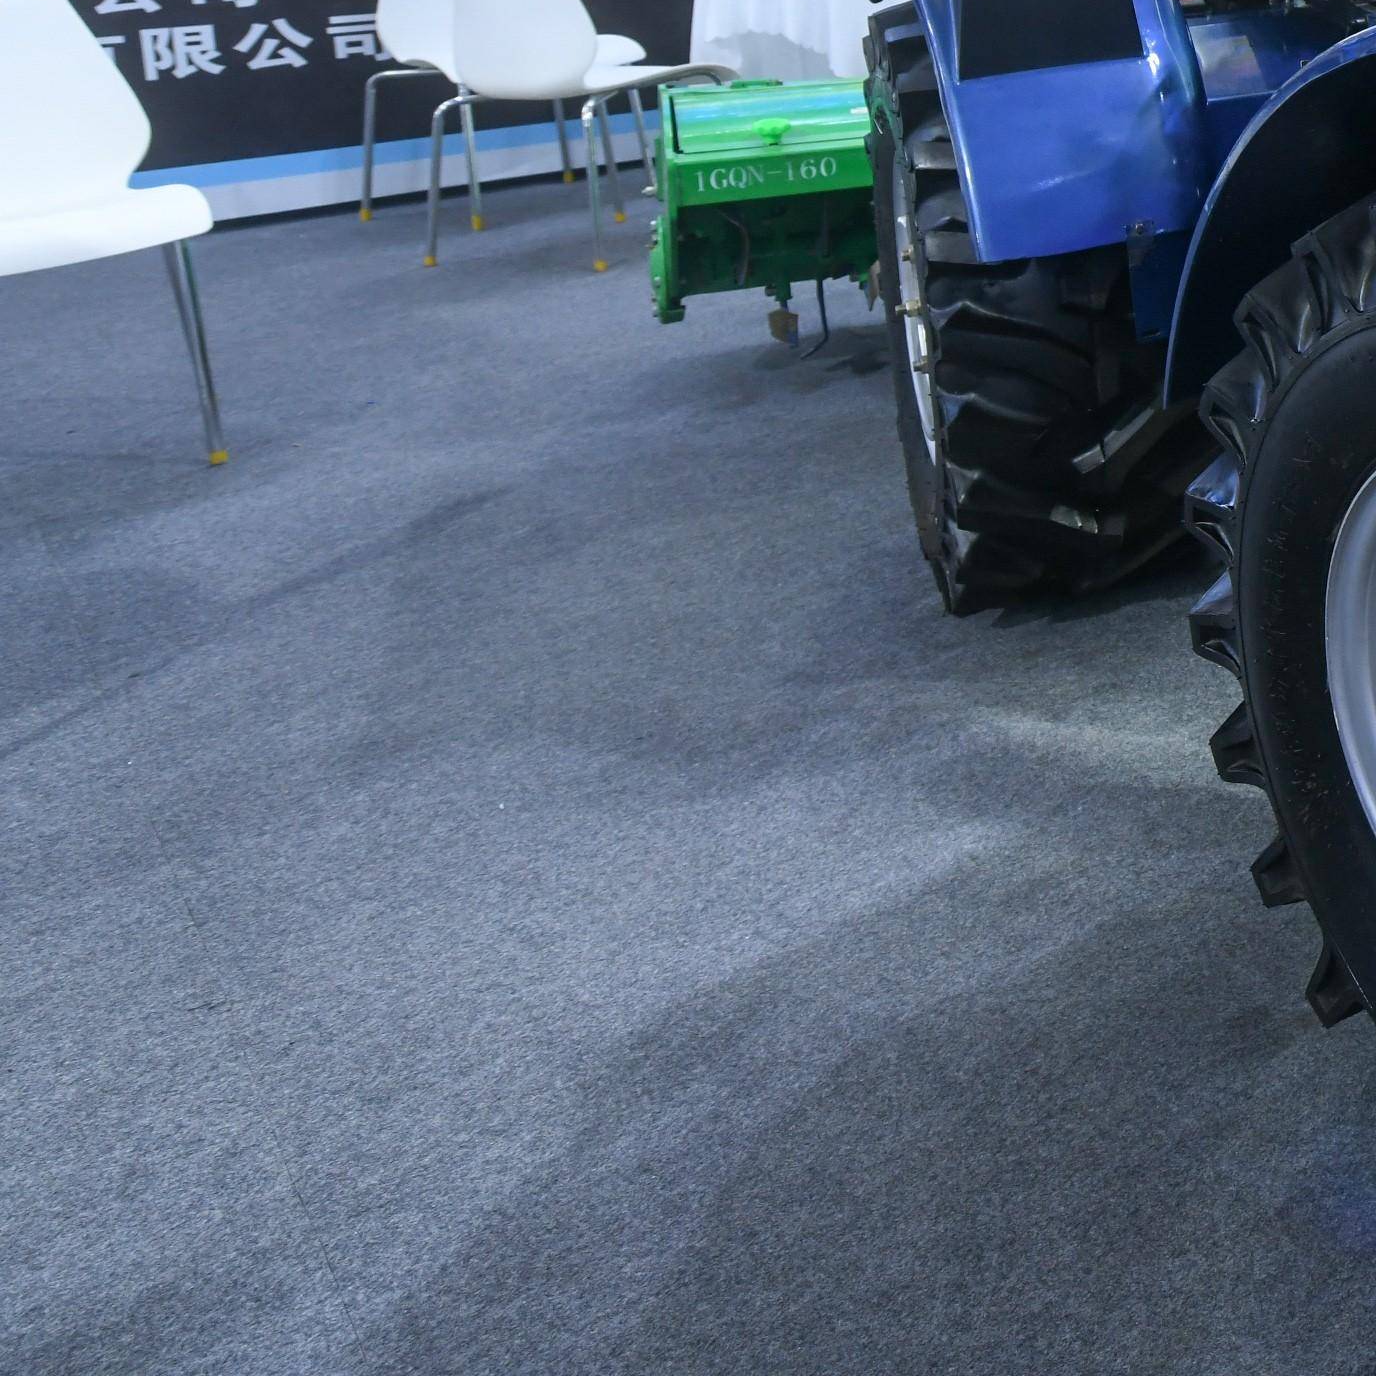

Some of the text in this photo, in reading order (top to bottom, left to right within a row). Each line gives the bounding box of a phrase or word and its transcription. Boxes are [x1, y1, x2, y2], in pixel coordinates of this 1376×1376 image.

[98, 13, 393, 81] 限公司
[695, 157, 837, 192] 1GQN-160
